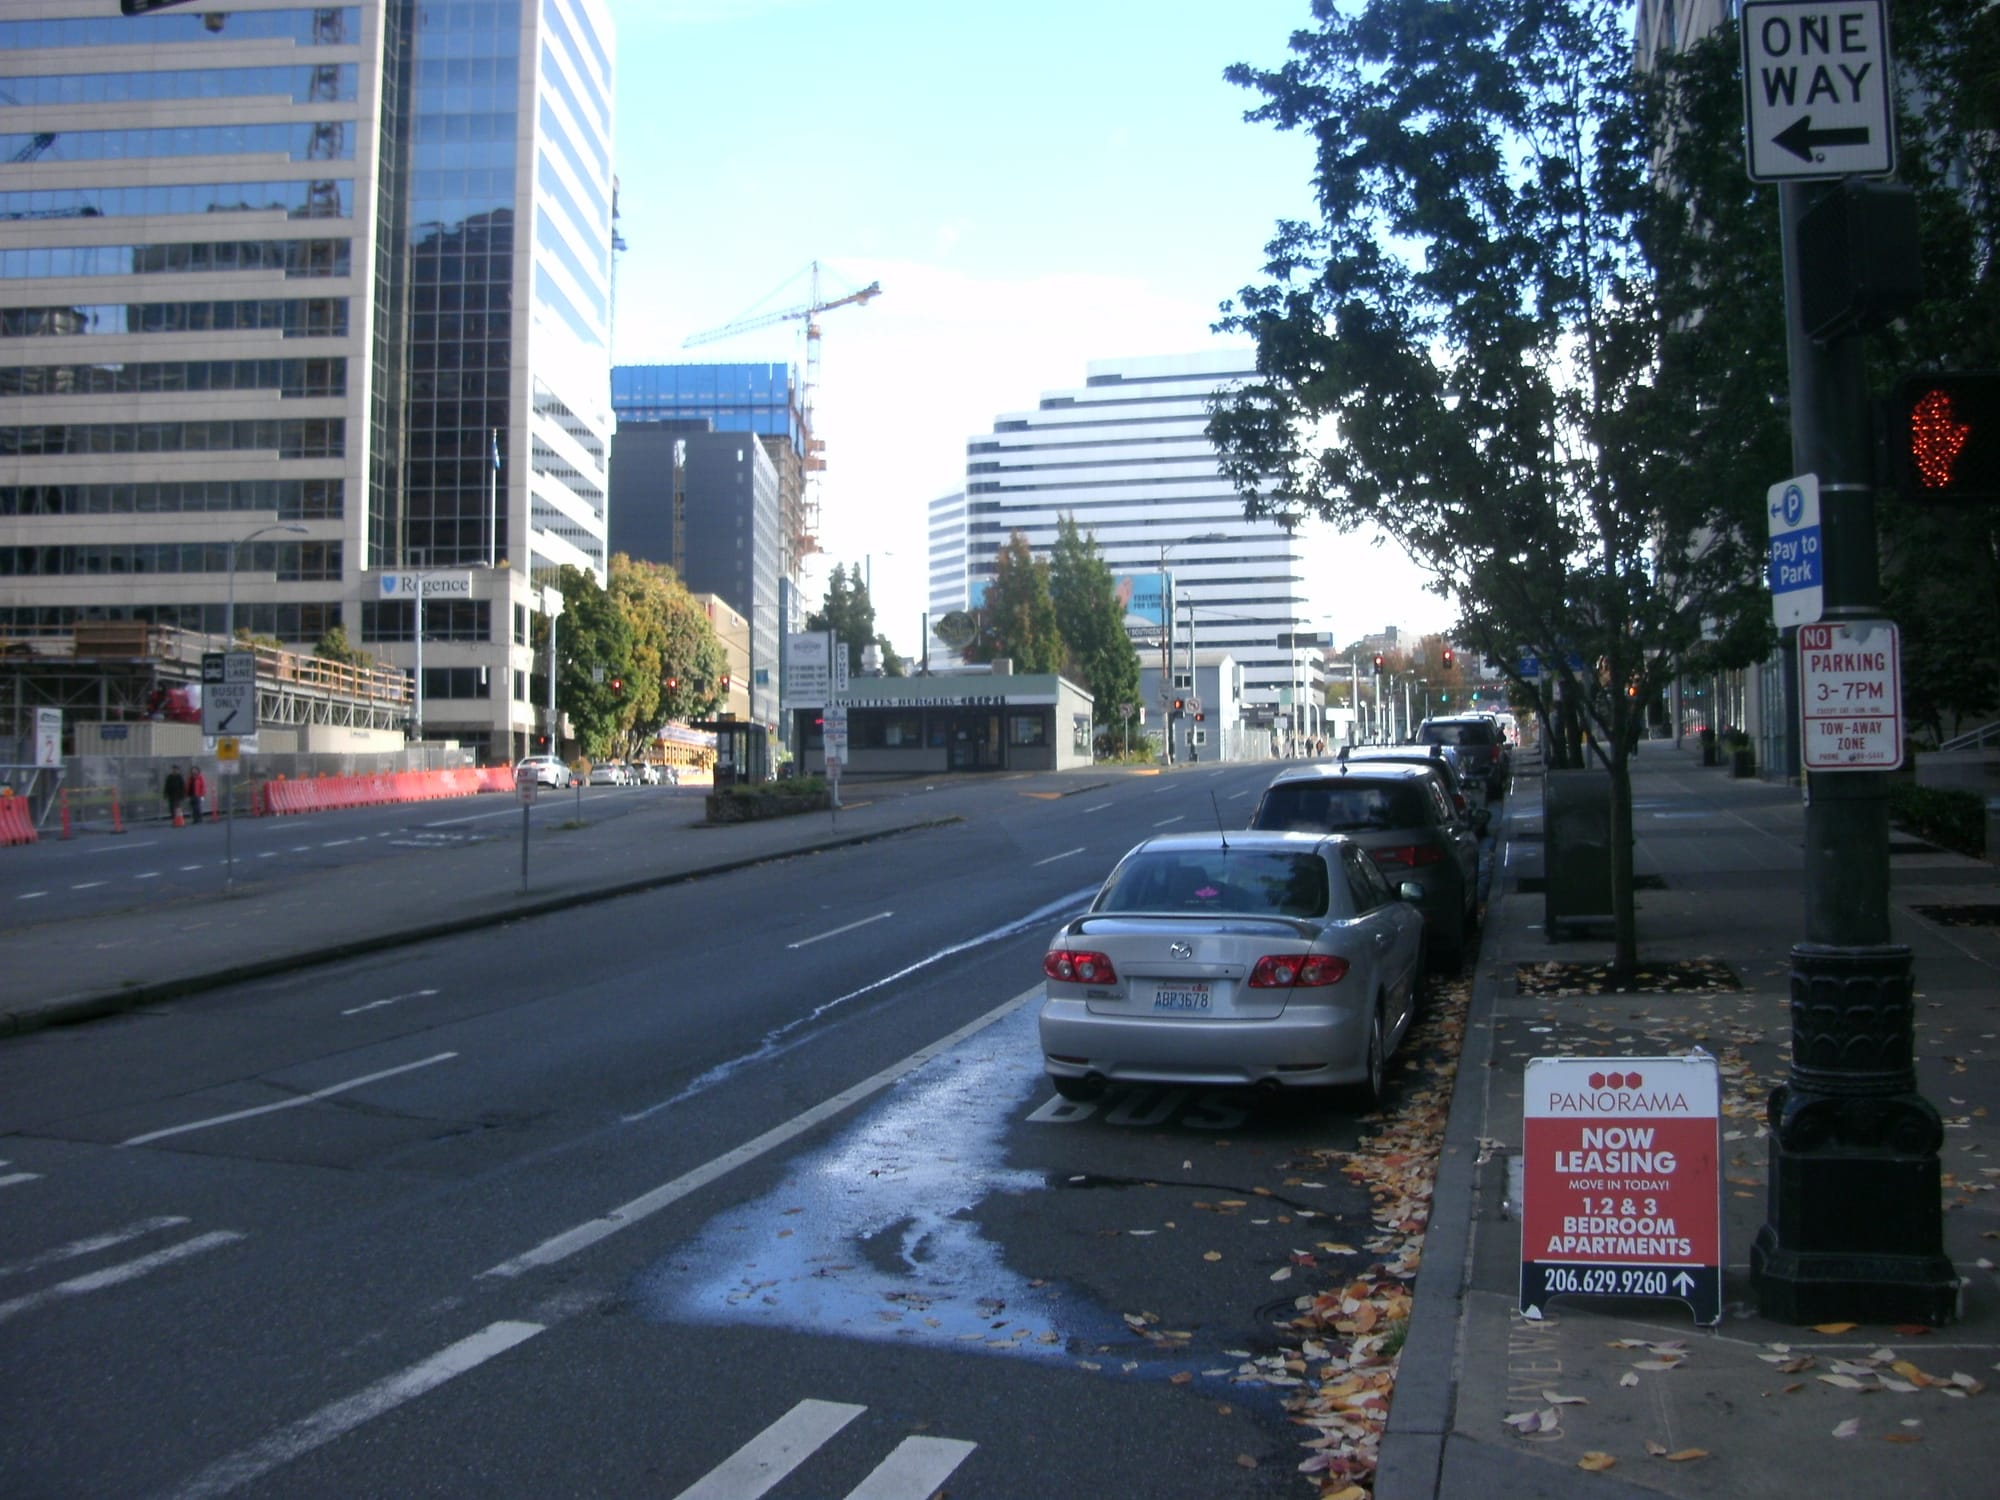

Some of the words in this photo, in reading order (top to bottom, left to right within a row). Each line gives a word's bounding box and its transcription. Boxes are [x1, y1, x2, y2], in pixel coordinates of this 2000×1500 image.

[1762, 14, 1867, 57] ONE
[1761, 62, 1872, 107] WAY
[1788, 495, 1799, 519] P
[1773, 540, 1798, 562] Pay
[1801, 535, 1817, 554] to
[1781, 560, 1812, 585] Park
[1804, 629, 1827, 647] NO
[1811, 652, 1885, 673] PARKING
[211, 686, 245, 697] BUSES
[215, 698, 242, 708] ONLY
[1820, 722, 1883, 735] TOW-AWAY
[1837, 737, 1866, 750] ZONE
[1025, 1089, 1250, 1129] BUS
[1549, 1092, 1689, 1112] PANORAMA
[1582, 1128, 1654, 1149] NOW
[1555, 1151, 1677, 1174] LEASING
[1568, 1179, 1604, 1190] MOVE
[1607, 1180, 1621, 1190] IN
[1625, 1180, 1670, 1191] TODAY!
[1620, 1198, 1637, 1215] &
[1643, 1198, 1657, 1215] 3
[1563, 1216, 1676, 1236] BEDROOM
[1546, 1236, 1692, 1256] APARTMENTS
[1545, 1268, 1667, 1294] 206.629.9260
